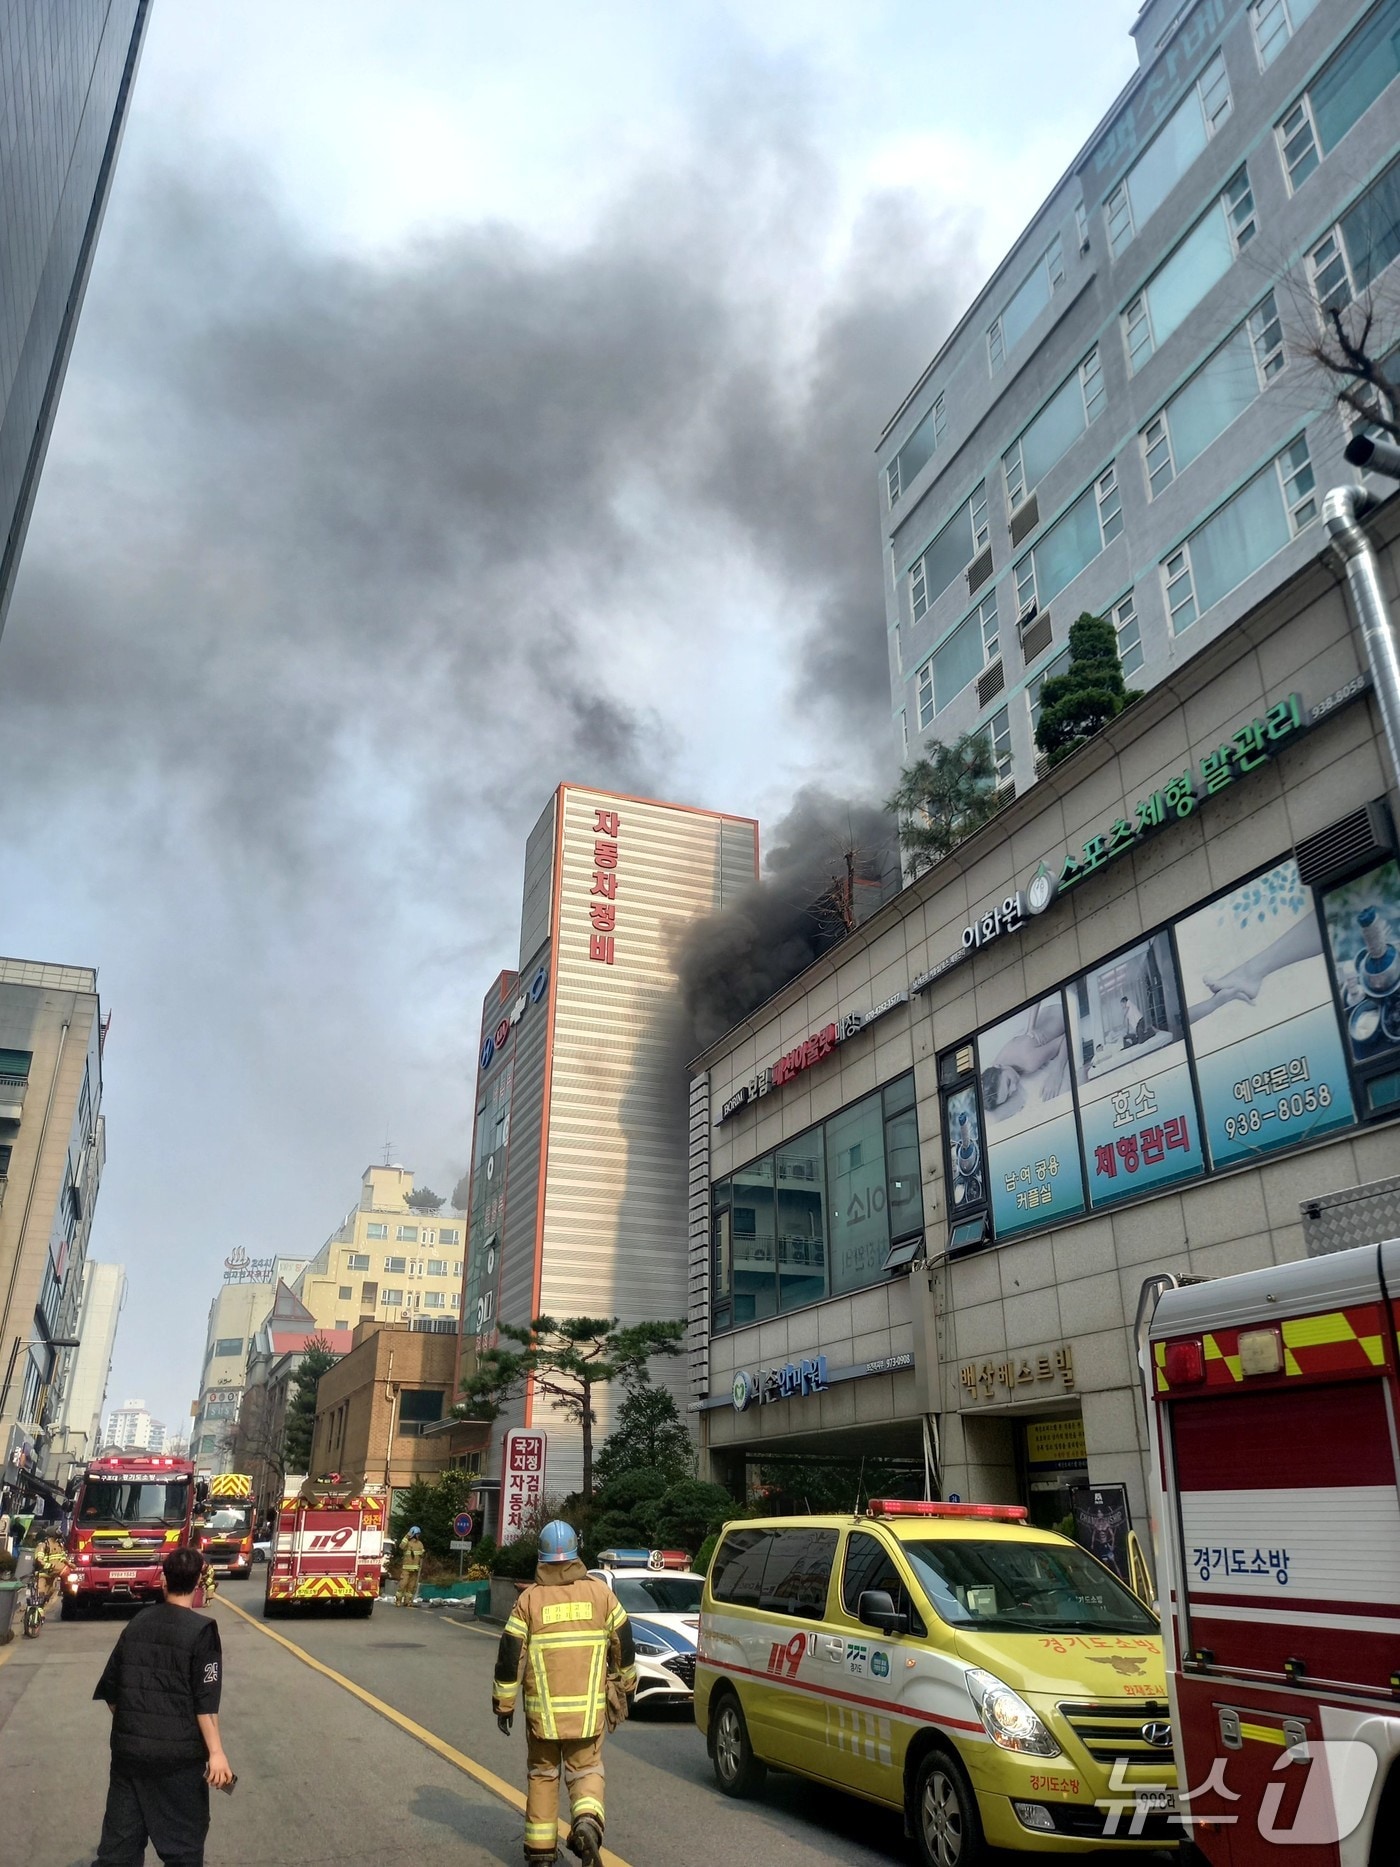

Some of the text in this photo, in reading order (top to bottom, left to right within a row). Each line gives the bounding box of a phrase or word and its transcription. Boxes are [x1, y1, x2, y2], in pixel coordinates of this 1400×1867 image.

[962, 891, 1025, 948] 이화원
[1057, 769, 1196, 892] 스포츠체형
[1200, 693, 1302, 795] 발관리
[590, 809, 620, 965] 자동차정비
[724, 1088, 743, 1116] BORIM
[747, 1068, 771, 1103] 보림
[772, 1024, 835, 1086] 패션아울렛
[835, 1011, 861, 1041] 매장
[1232, 1056, 1310, 1103] 예약문의
[1111, 1083, 1158, 1128] 효소
[1224, 1084, 1332, 1140] 938-8058
[1094, 1115, 1190, 1178] 체형관리
[1035, 1155, 1060, 1181] 공용
[1016, 1183, 1053, 1211] 커플실
[961, 1345, 1075, 1400] 백산베스트빌
[514, 1455, 538, 1470] 지정
[515, 1439, 540, 1454] 국가
[363, 1514, 381, 1526] 화전
[508, 1475, 525, 1530] 자동차
[308, 1527, 354, 1550] 119
[1193, 1547, 1290, 1585] 경기도소방
[767, 1632, 806, 1679] 119
[1038, 1637, 1161, 1654] 경기도소방
[203, 1662, 218, 1684] 25
[1123, 1684, 1165, 1696] 화재조사
[1029, 1774, 1080, 1795] 경기도소방
